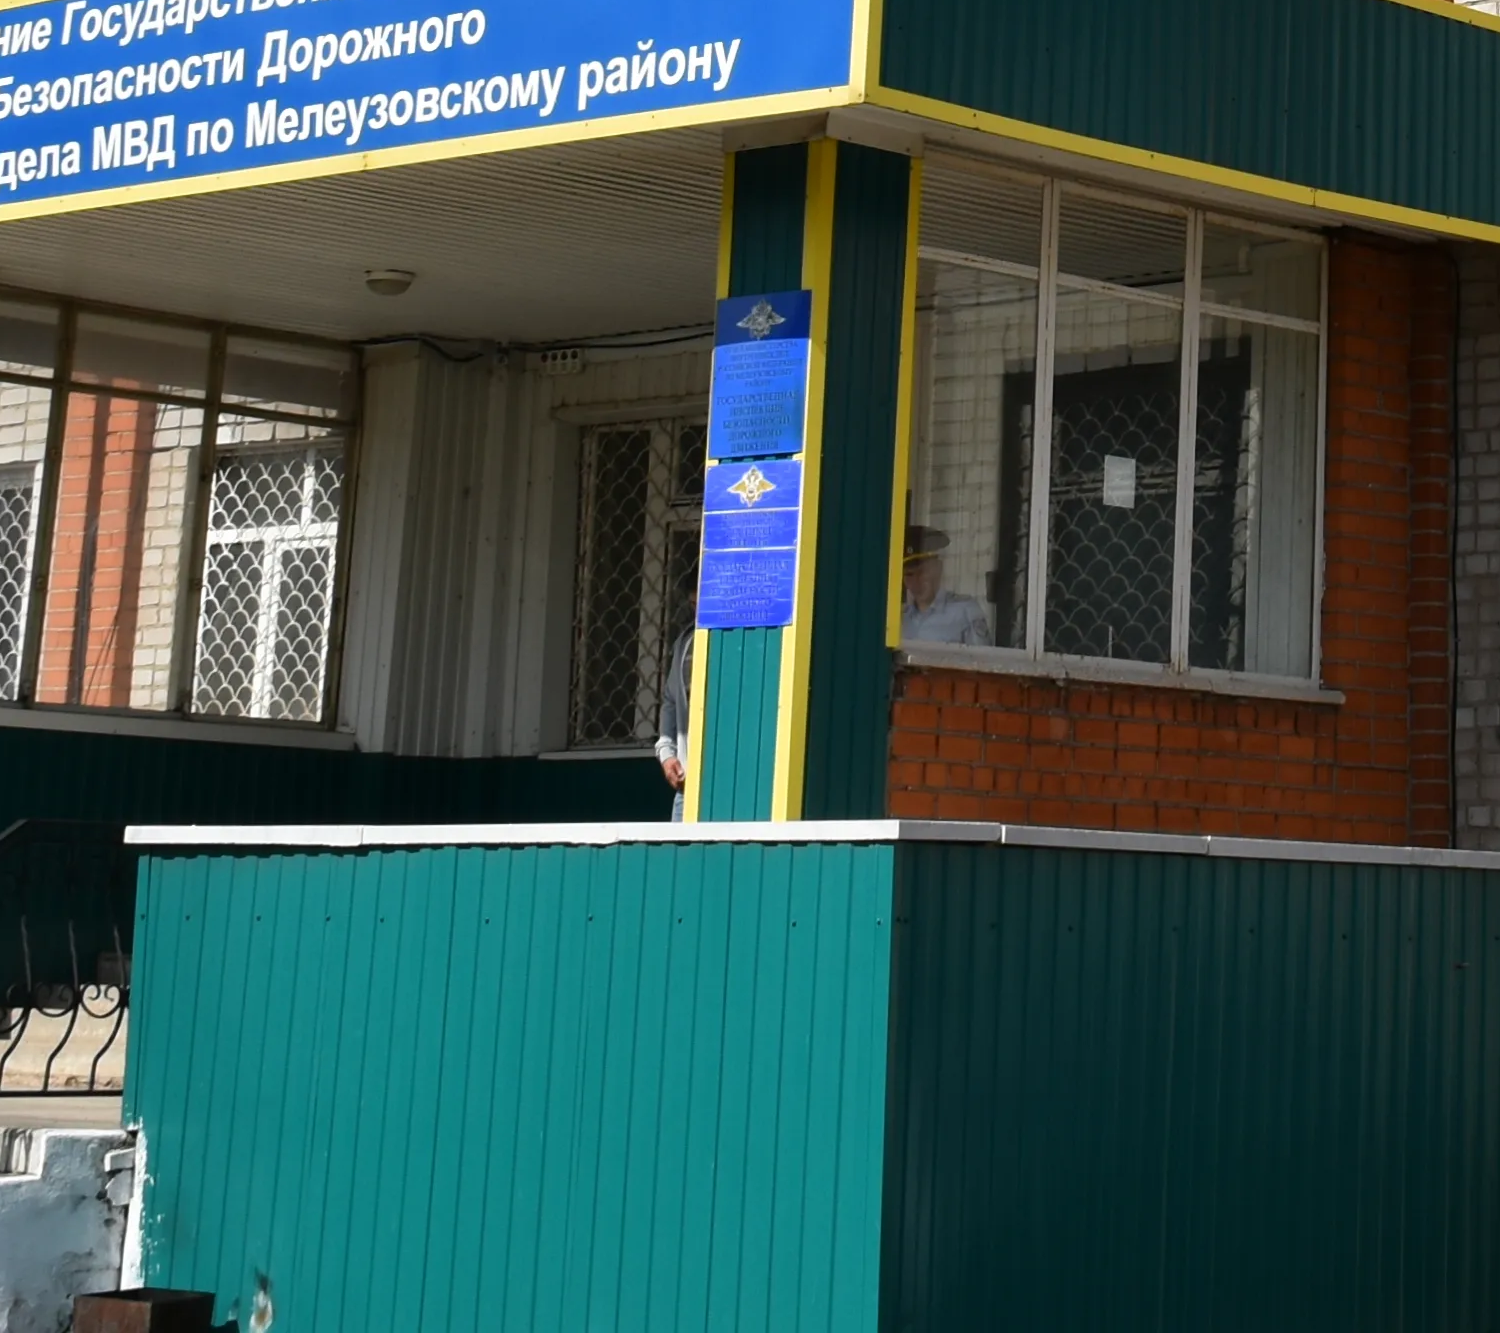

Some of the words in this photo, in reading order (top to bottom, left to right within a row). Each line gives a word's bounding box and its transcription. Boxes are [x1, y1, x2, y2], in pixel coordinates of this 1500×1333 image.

[256, 9, 486, 84] Дорожного
[92, 115, 176, 172] МВД
[186, 118, 234, 157] по
[245, 66, 566, 148] Мелеузовскому
[578, 38, 741, 111] району
